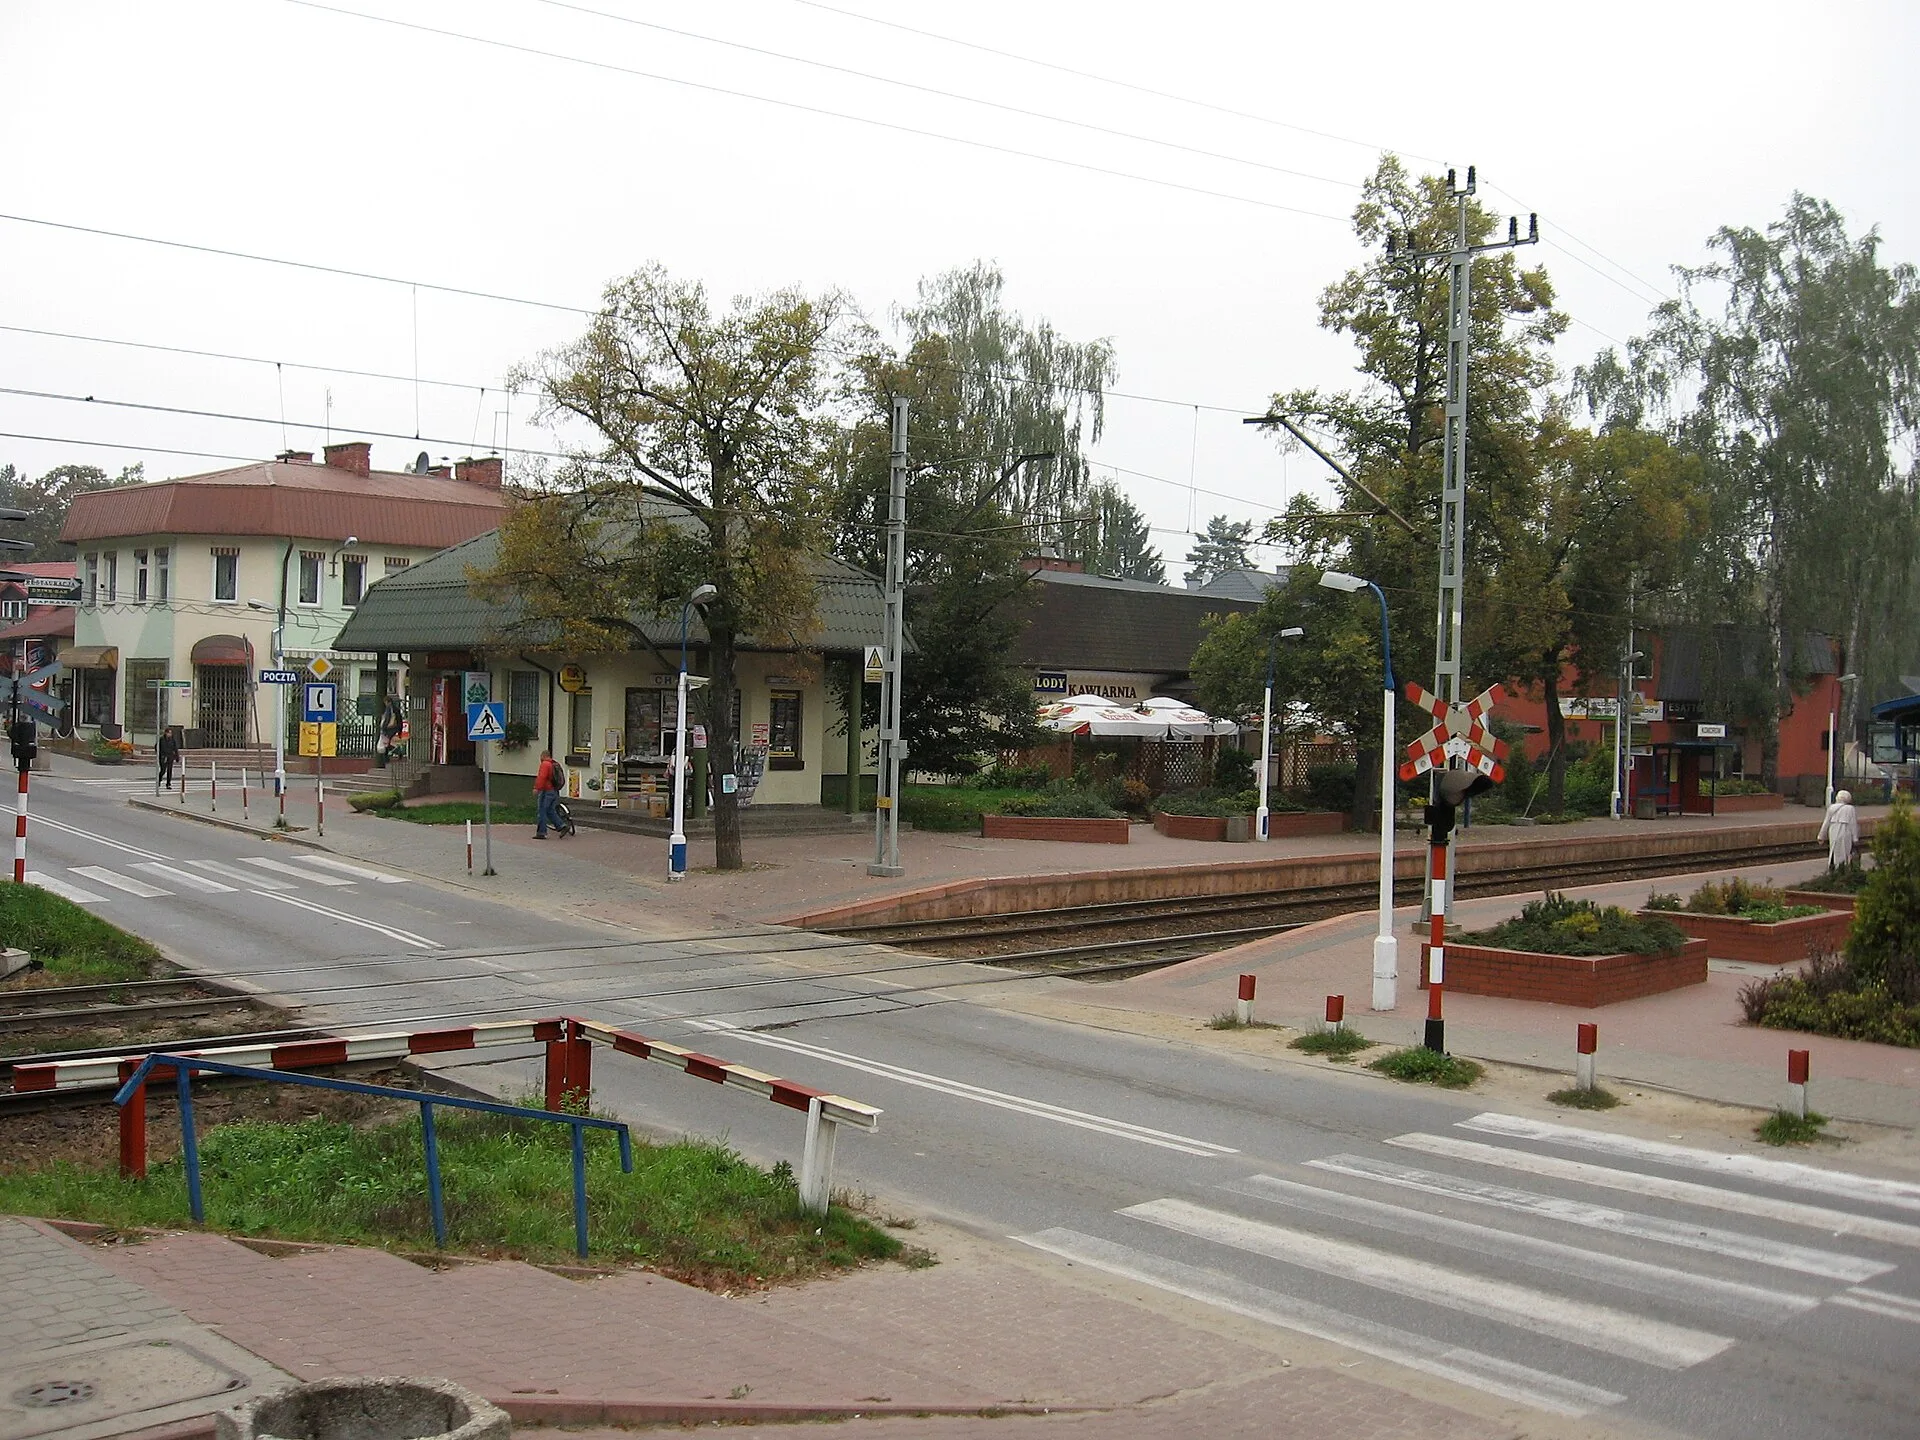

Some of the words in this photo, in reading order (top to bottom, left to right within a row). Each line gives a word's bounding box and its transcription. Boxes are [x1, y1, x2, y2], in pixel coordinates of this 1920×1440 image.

[263, 672, 297, 681] POCZTA
[1036, 678, 1065, 688] LODY
[1068, 684, 1137, 698] KAWIARNIA
